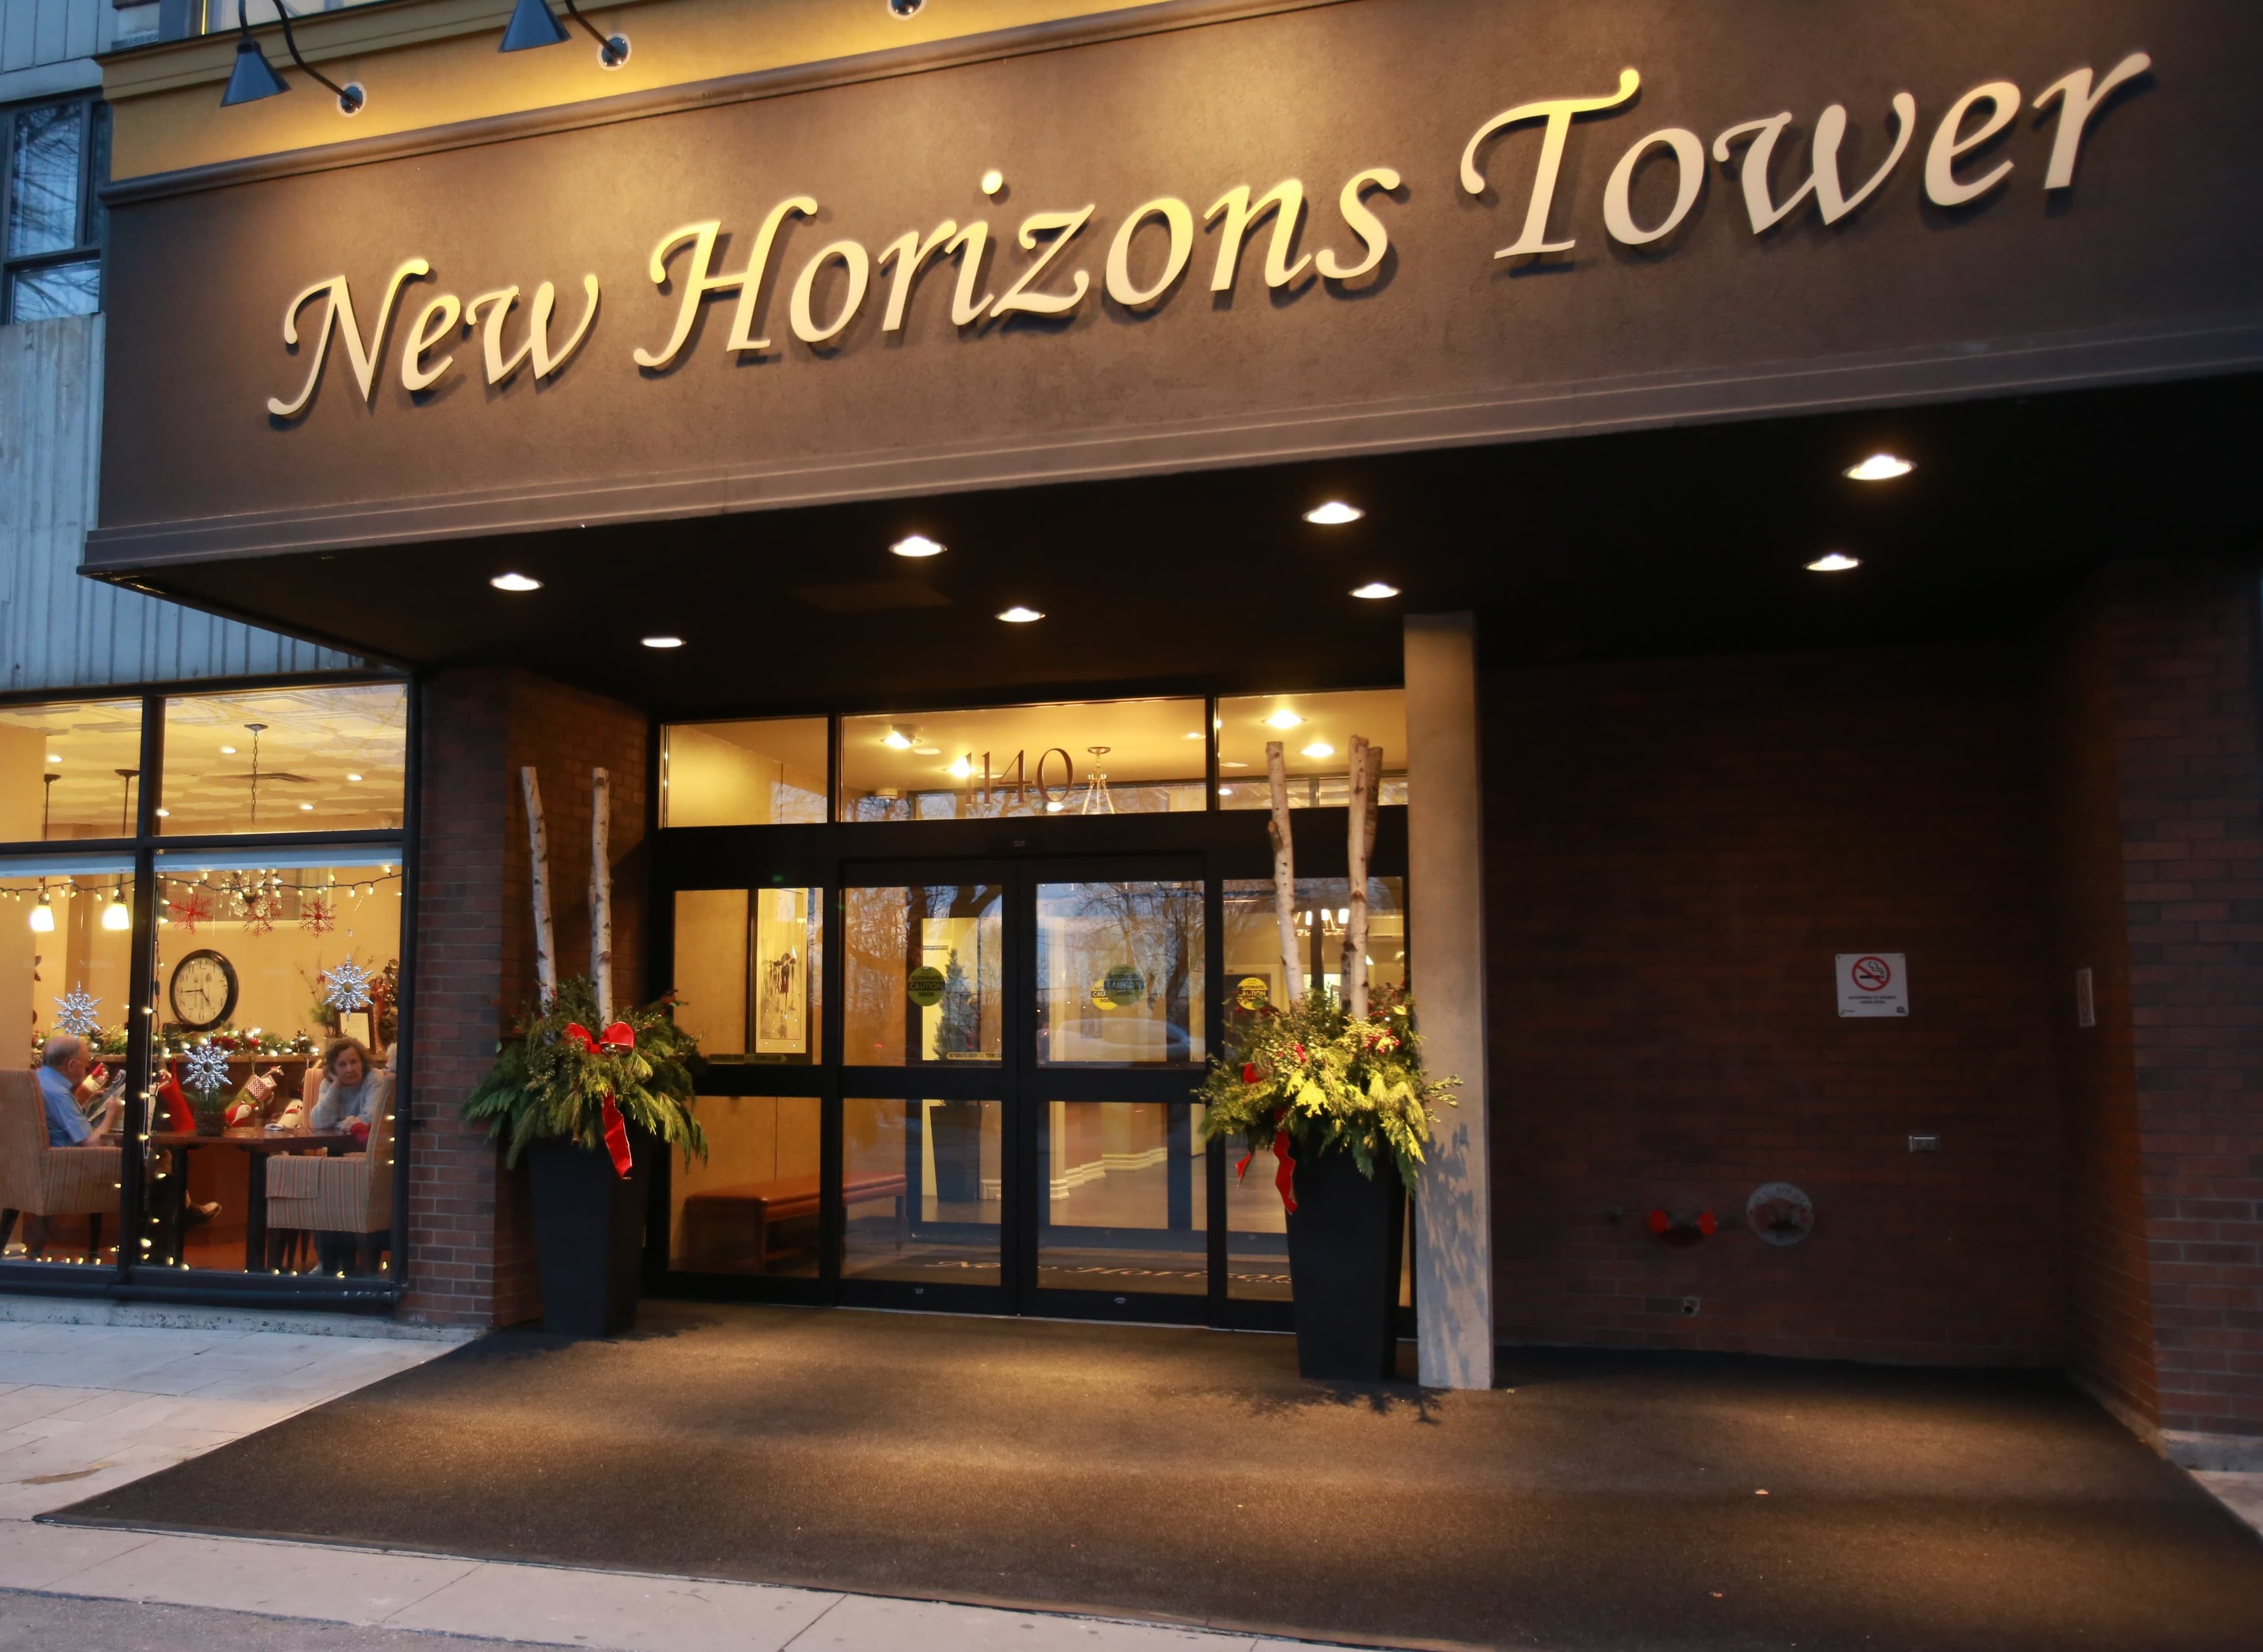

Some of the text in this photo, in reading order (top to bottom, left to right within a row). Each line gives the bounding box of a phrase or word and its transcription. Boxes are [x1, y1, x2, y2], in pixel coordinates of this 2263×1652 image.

[268, 53, 2150, 415] New Horizons Tower
[965, 748, 1073, 805] 1140
